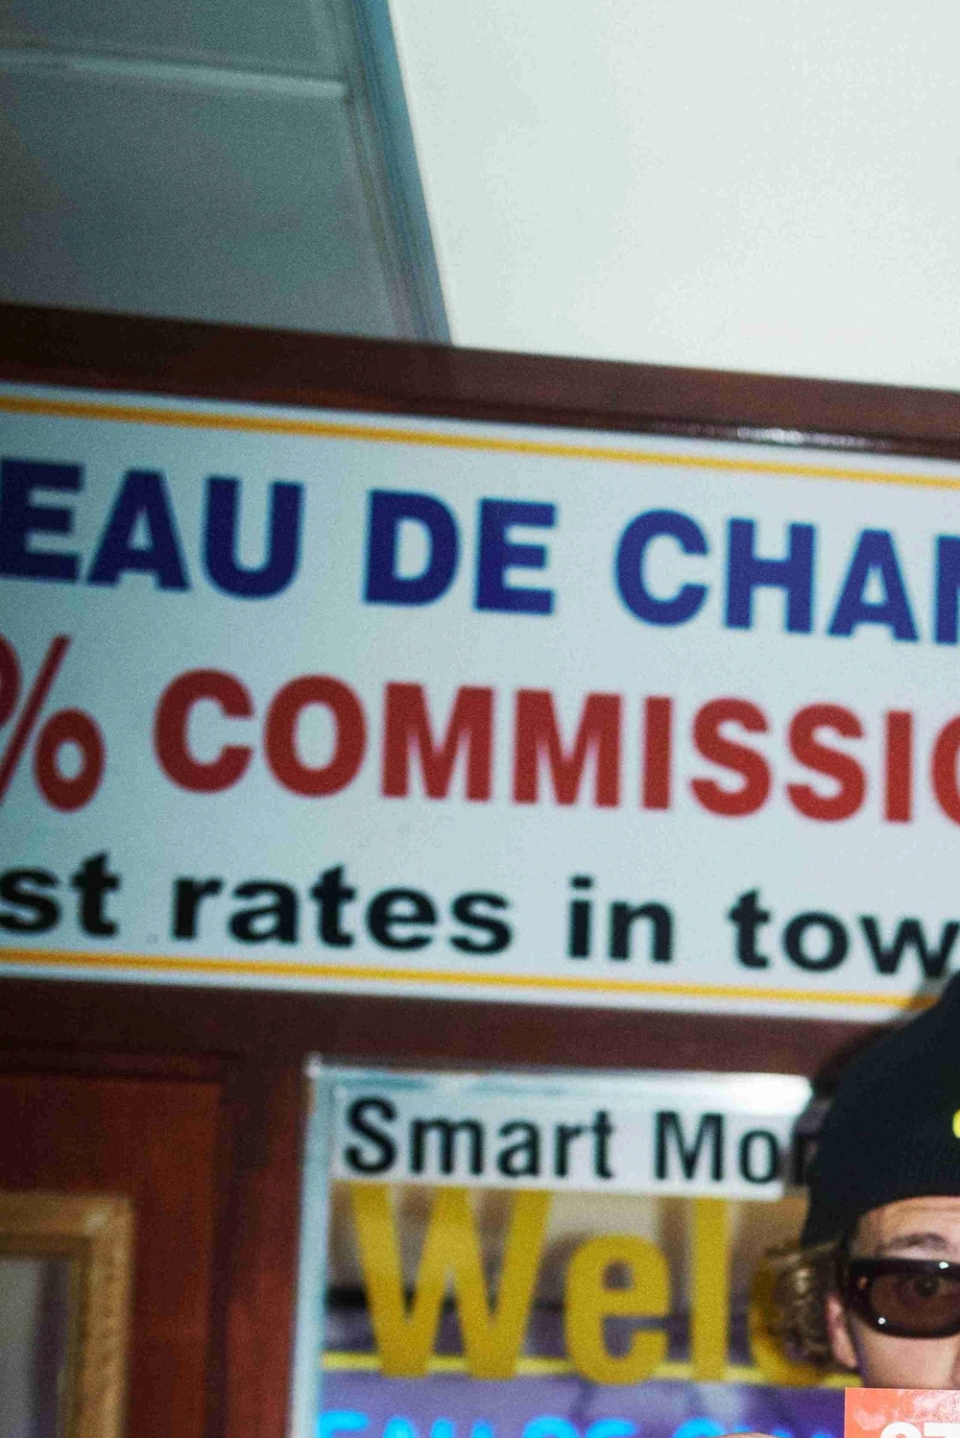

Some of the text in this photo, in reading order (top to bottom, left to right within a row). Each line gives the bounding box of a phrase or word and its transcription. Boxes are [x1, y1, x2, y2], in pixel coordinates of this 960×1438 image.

[0, 457, 304, 600] EAU
[361, 488, 558, 616] DE
[0, 851, 120, 939] st
[171, 863, 514, 956] rates
[566, 874, 675, 965] in
[344, 1096, 614, 1183] Smart
